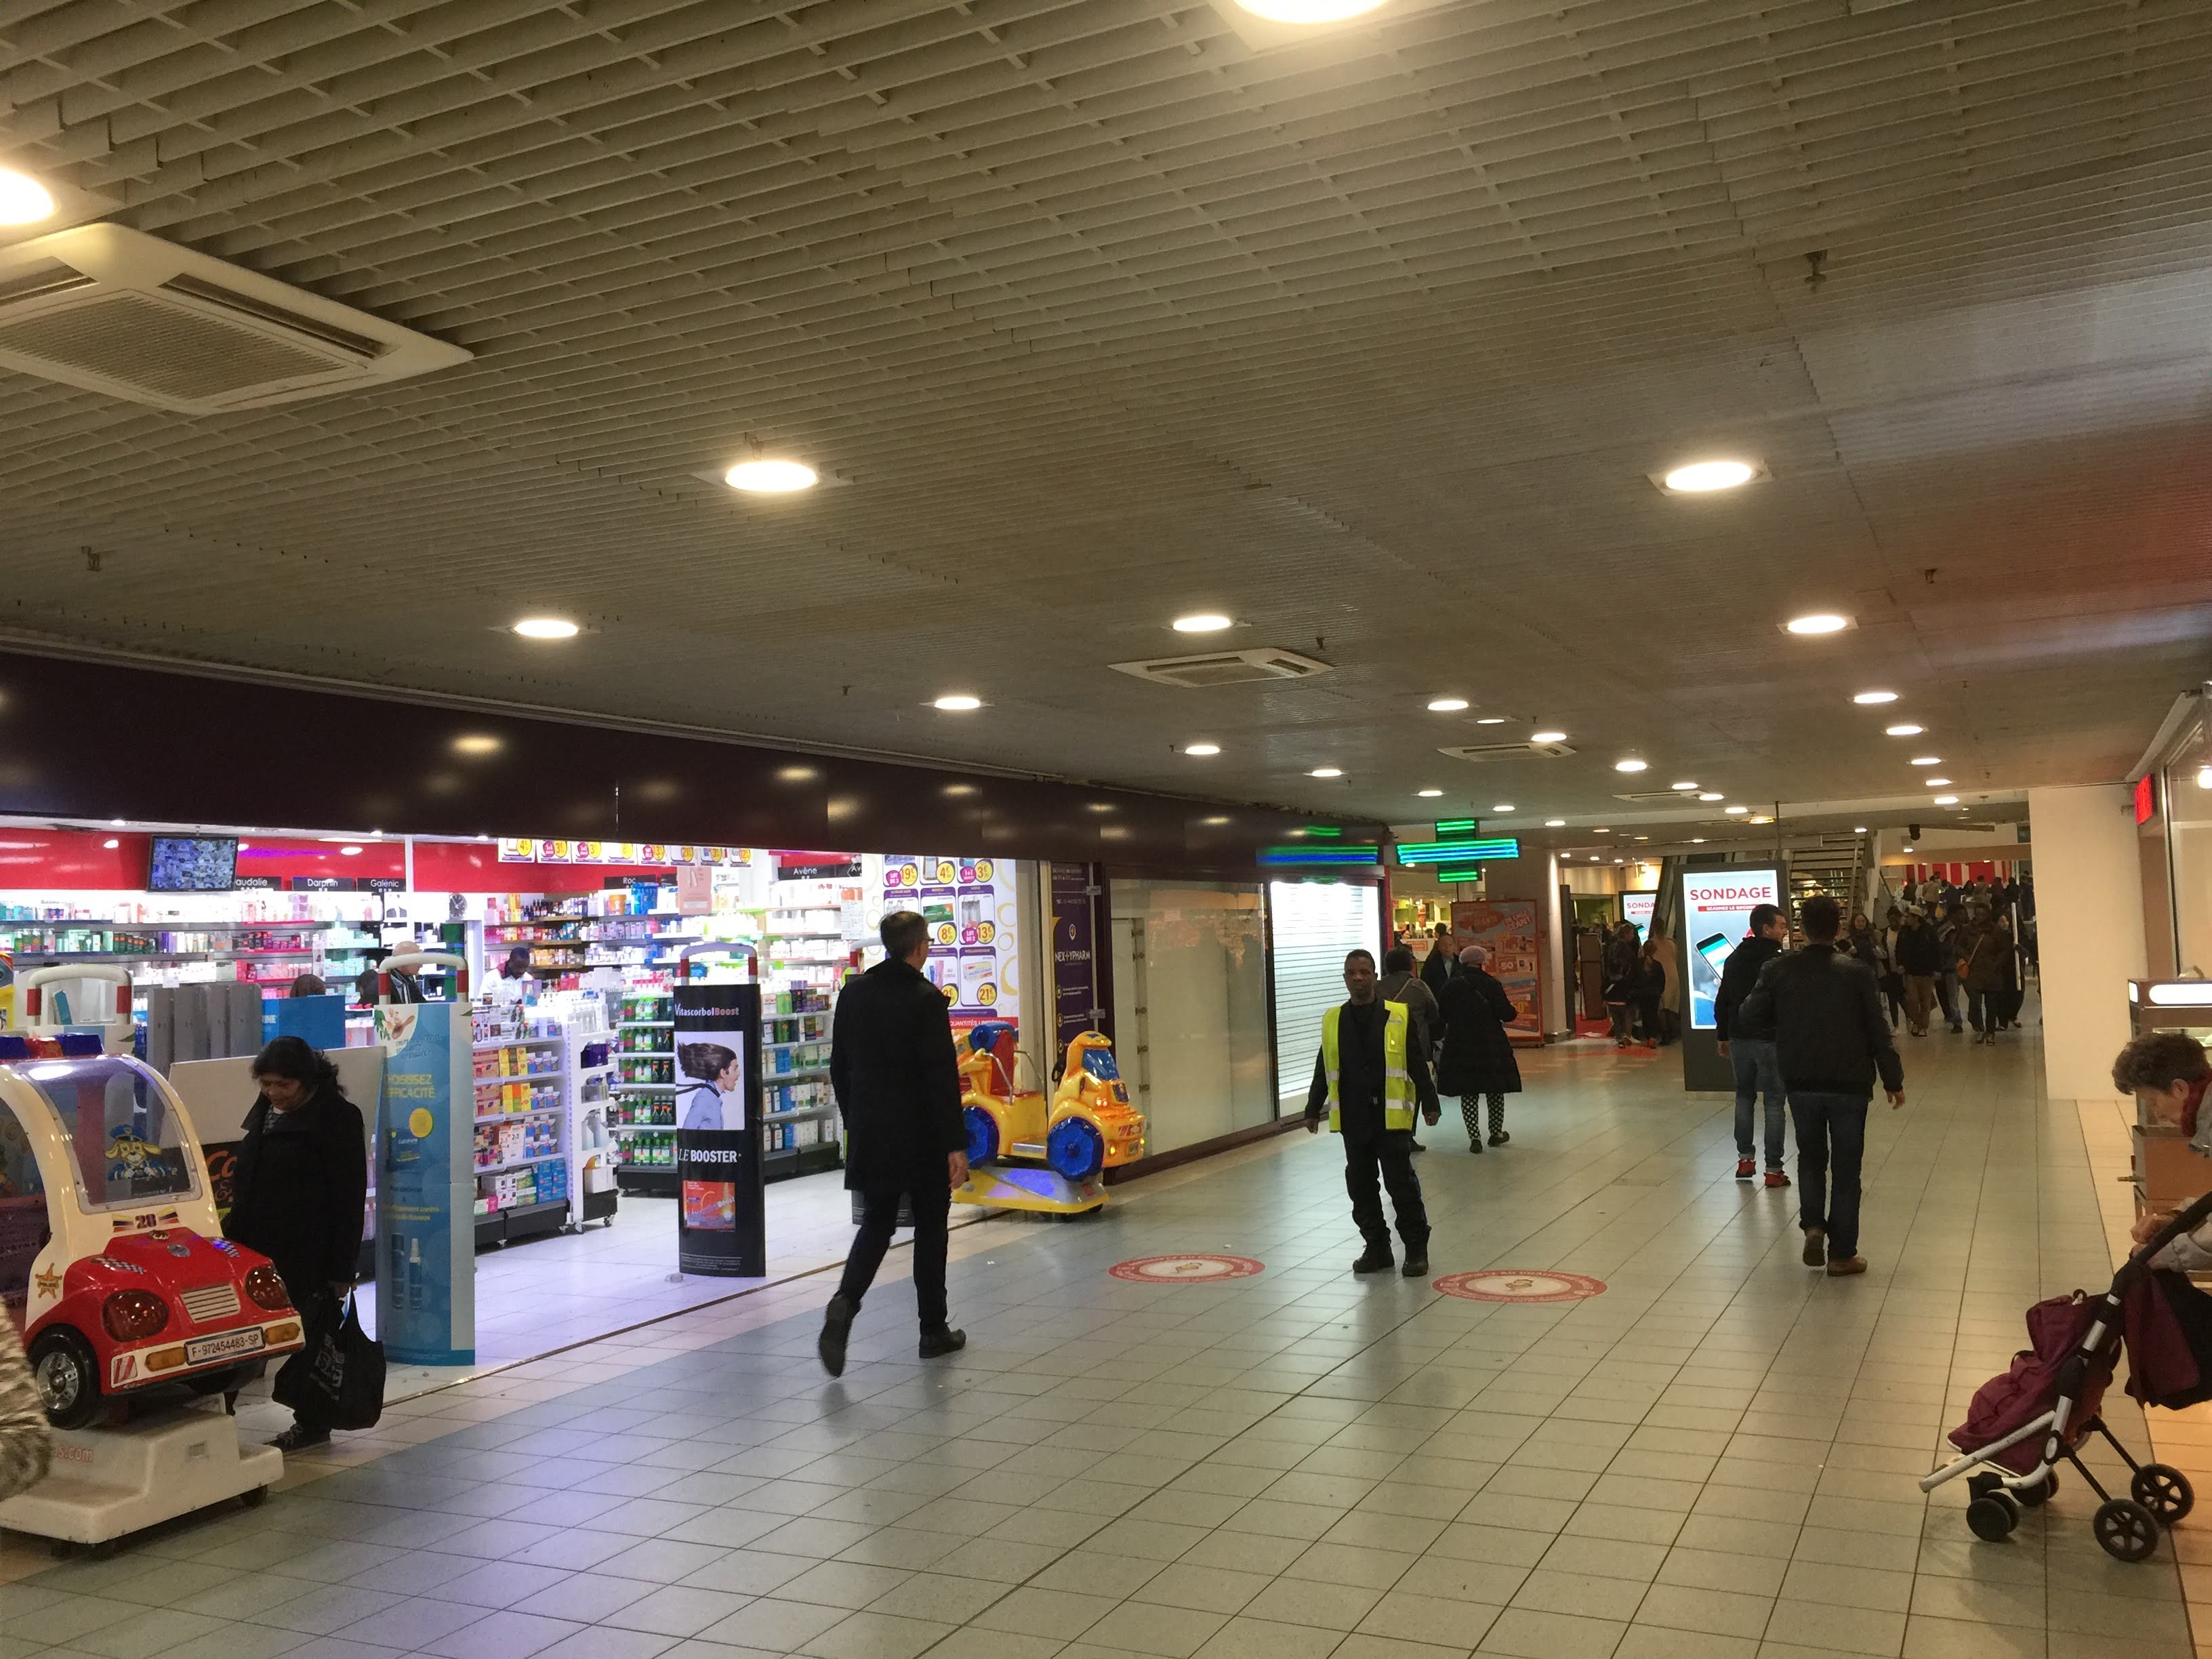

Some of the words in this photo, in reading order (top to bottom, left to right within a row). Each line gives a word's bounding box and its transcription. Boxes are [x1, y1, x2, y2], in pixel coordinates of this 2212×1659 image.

[793, 867, 818, 875] Avène
[370, 878, 399, 888] Galénic
[1689, 886, 1771, 901] SONDAGE
[678, 1148, 689, 1161] LE
[691, 1149, 738, 1163] BOOSTER
[135, 1213, 157, 1229] 20
